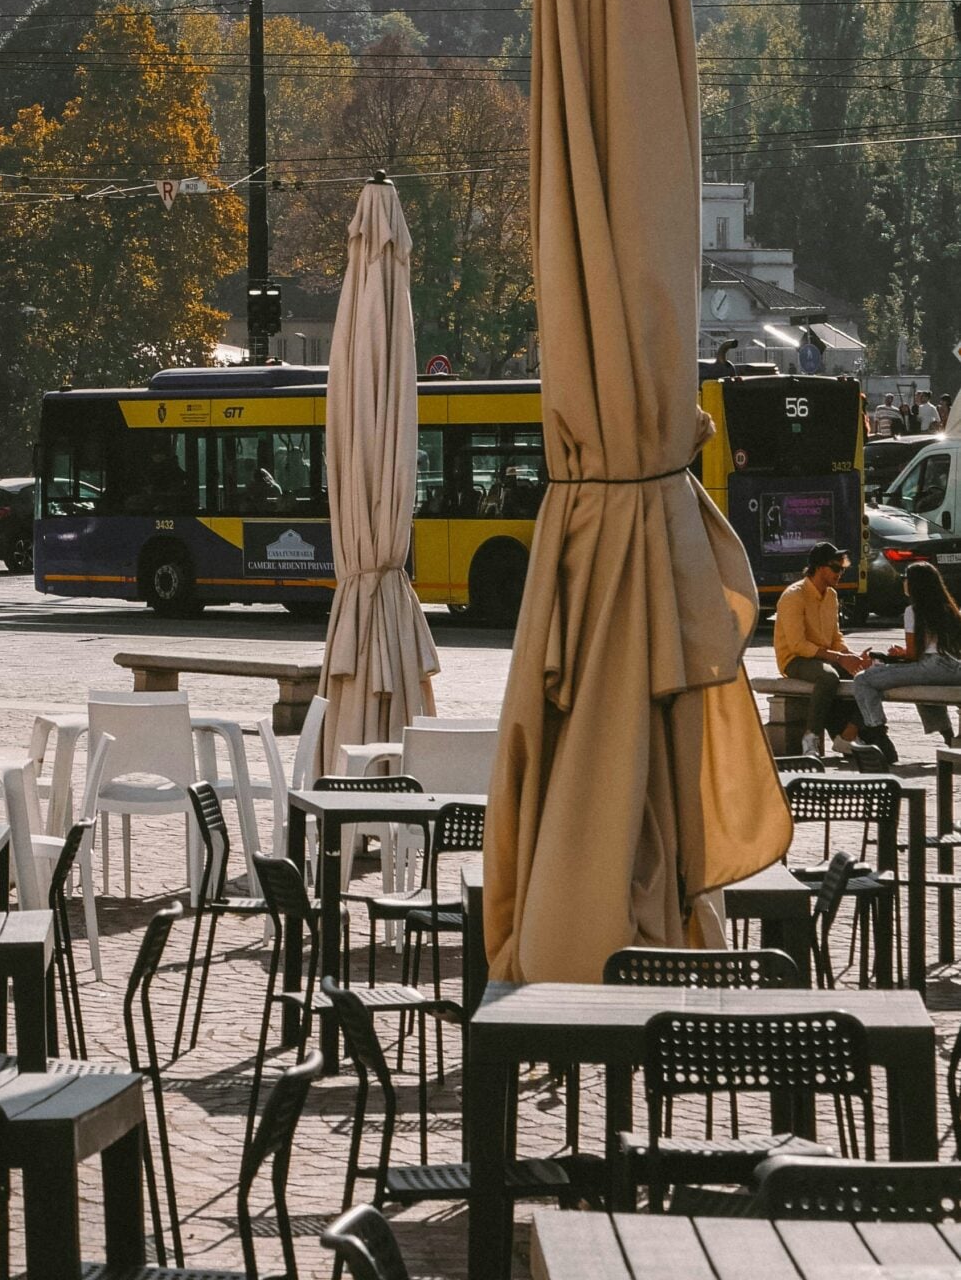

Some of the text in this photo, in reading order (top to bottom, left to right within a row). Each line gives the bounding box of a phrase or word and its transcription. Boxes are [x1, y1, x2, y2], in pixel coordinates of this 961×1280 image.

[162, 181, 173, 201] R
[785, 397, 809, 417] 56
[223, 407, 244, 419] GTT
[831, 461, 851, 472] 3432
[155, 519, 175, 530] 3432
[248, 561, 275, 570] CAMERE
[277, 561, 307, 570] ARDENTI
